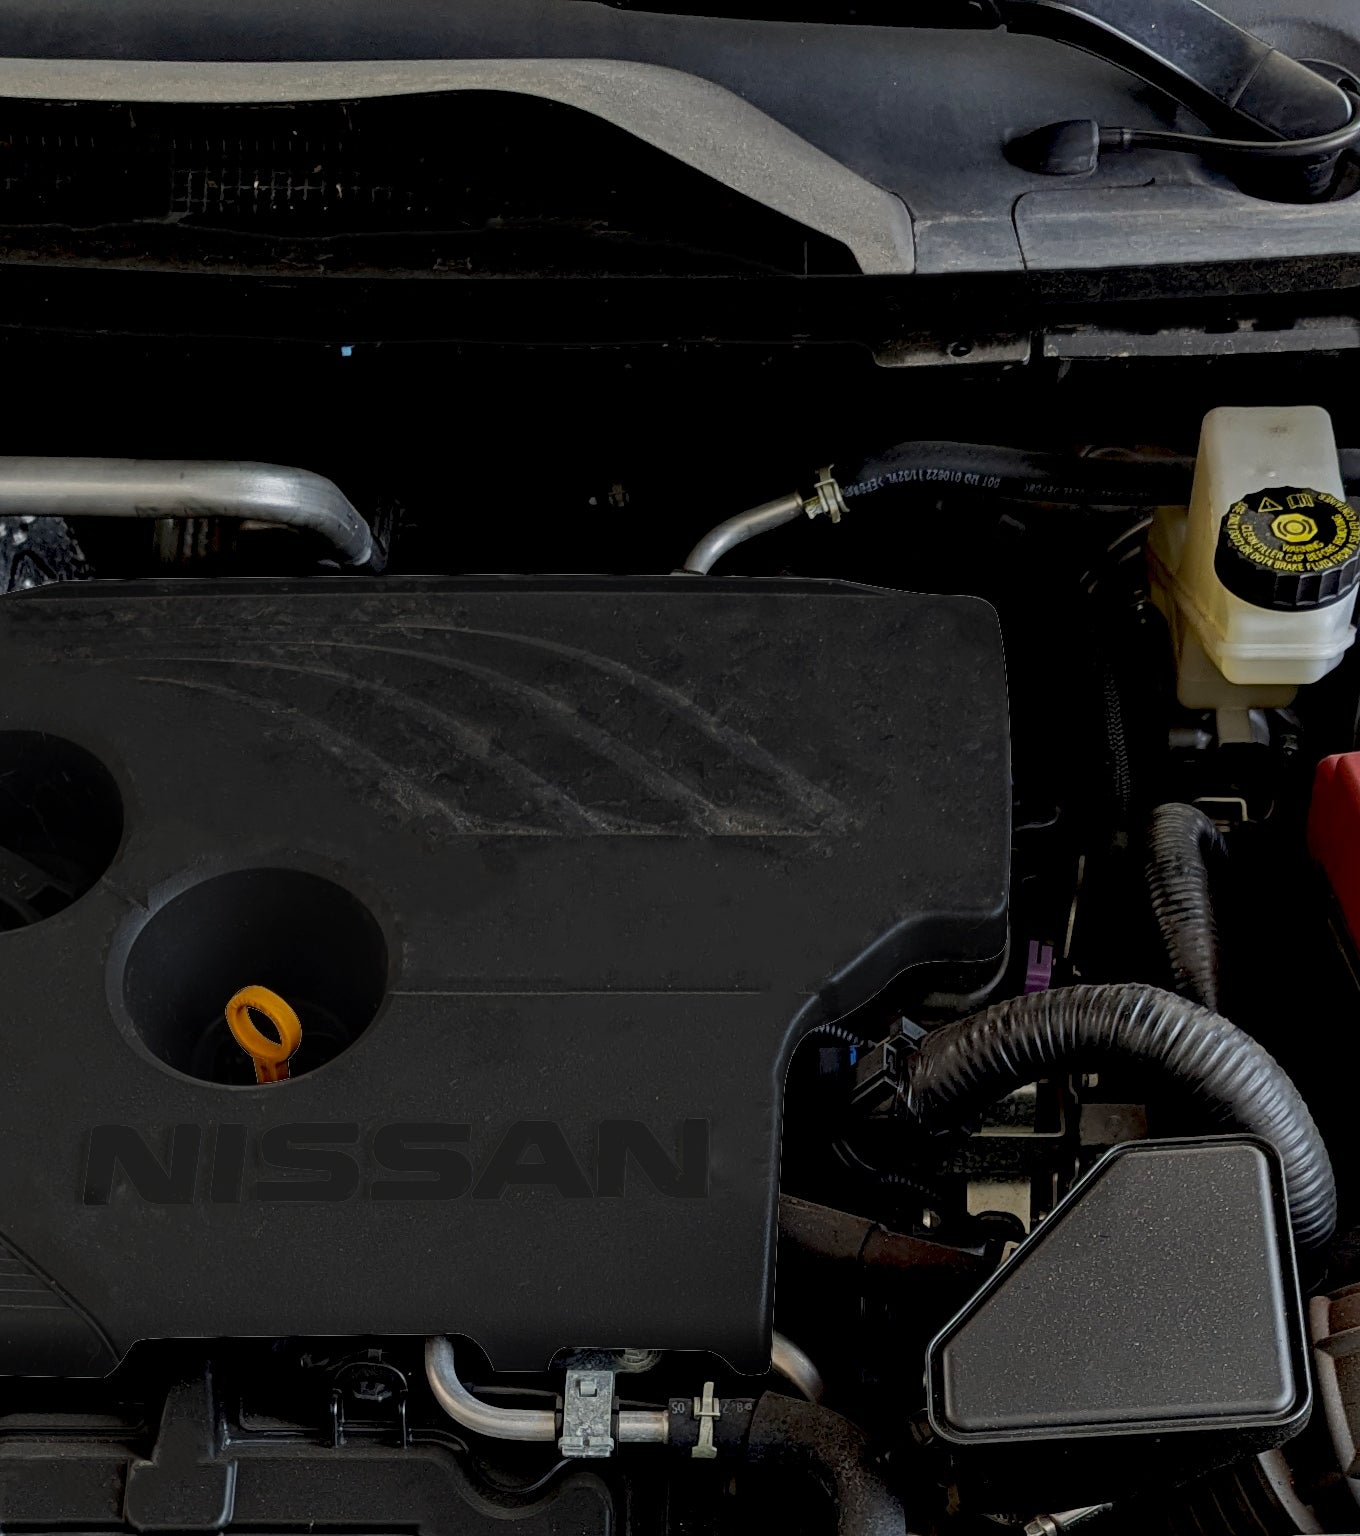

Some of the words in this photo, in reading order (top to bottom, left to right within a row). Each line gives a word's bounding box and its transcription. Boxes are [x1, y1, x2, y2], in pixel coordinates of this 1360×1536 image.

[1256, 542, 1284, 561] FILLER
[1285, 553, 1304, 562] CAP
[1306, 544, 1339, 561] BEFORE
[1283, 541, 1324, 552] WARNING
[1274, 560, 1304, 572] BRAKE
[1306, 560, 1333, 572] FLUID
[82, 1117, 711, 1206] NISSAN
